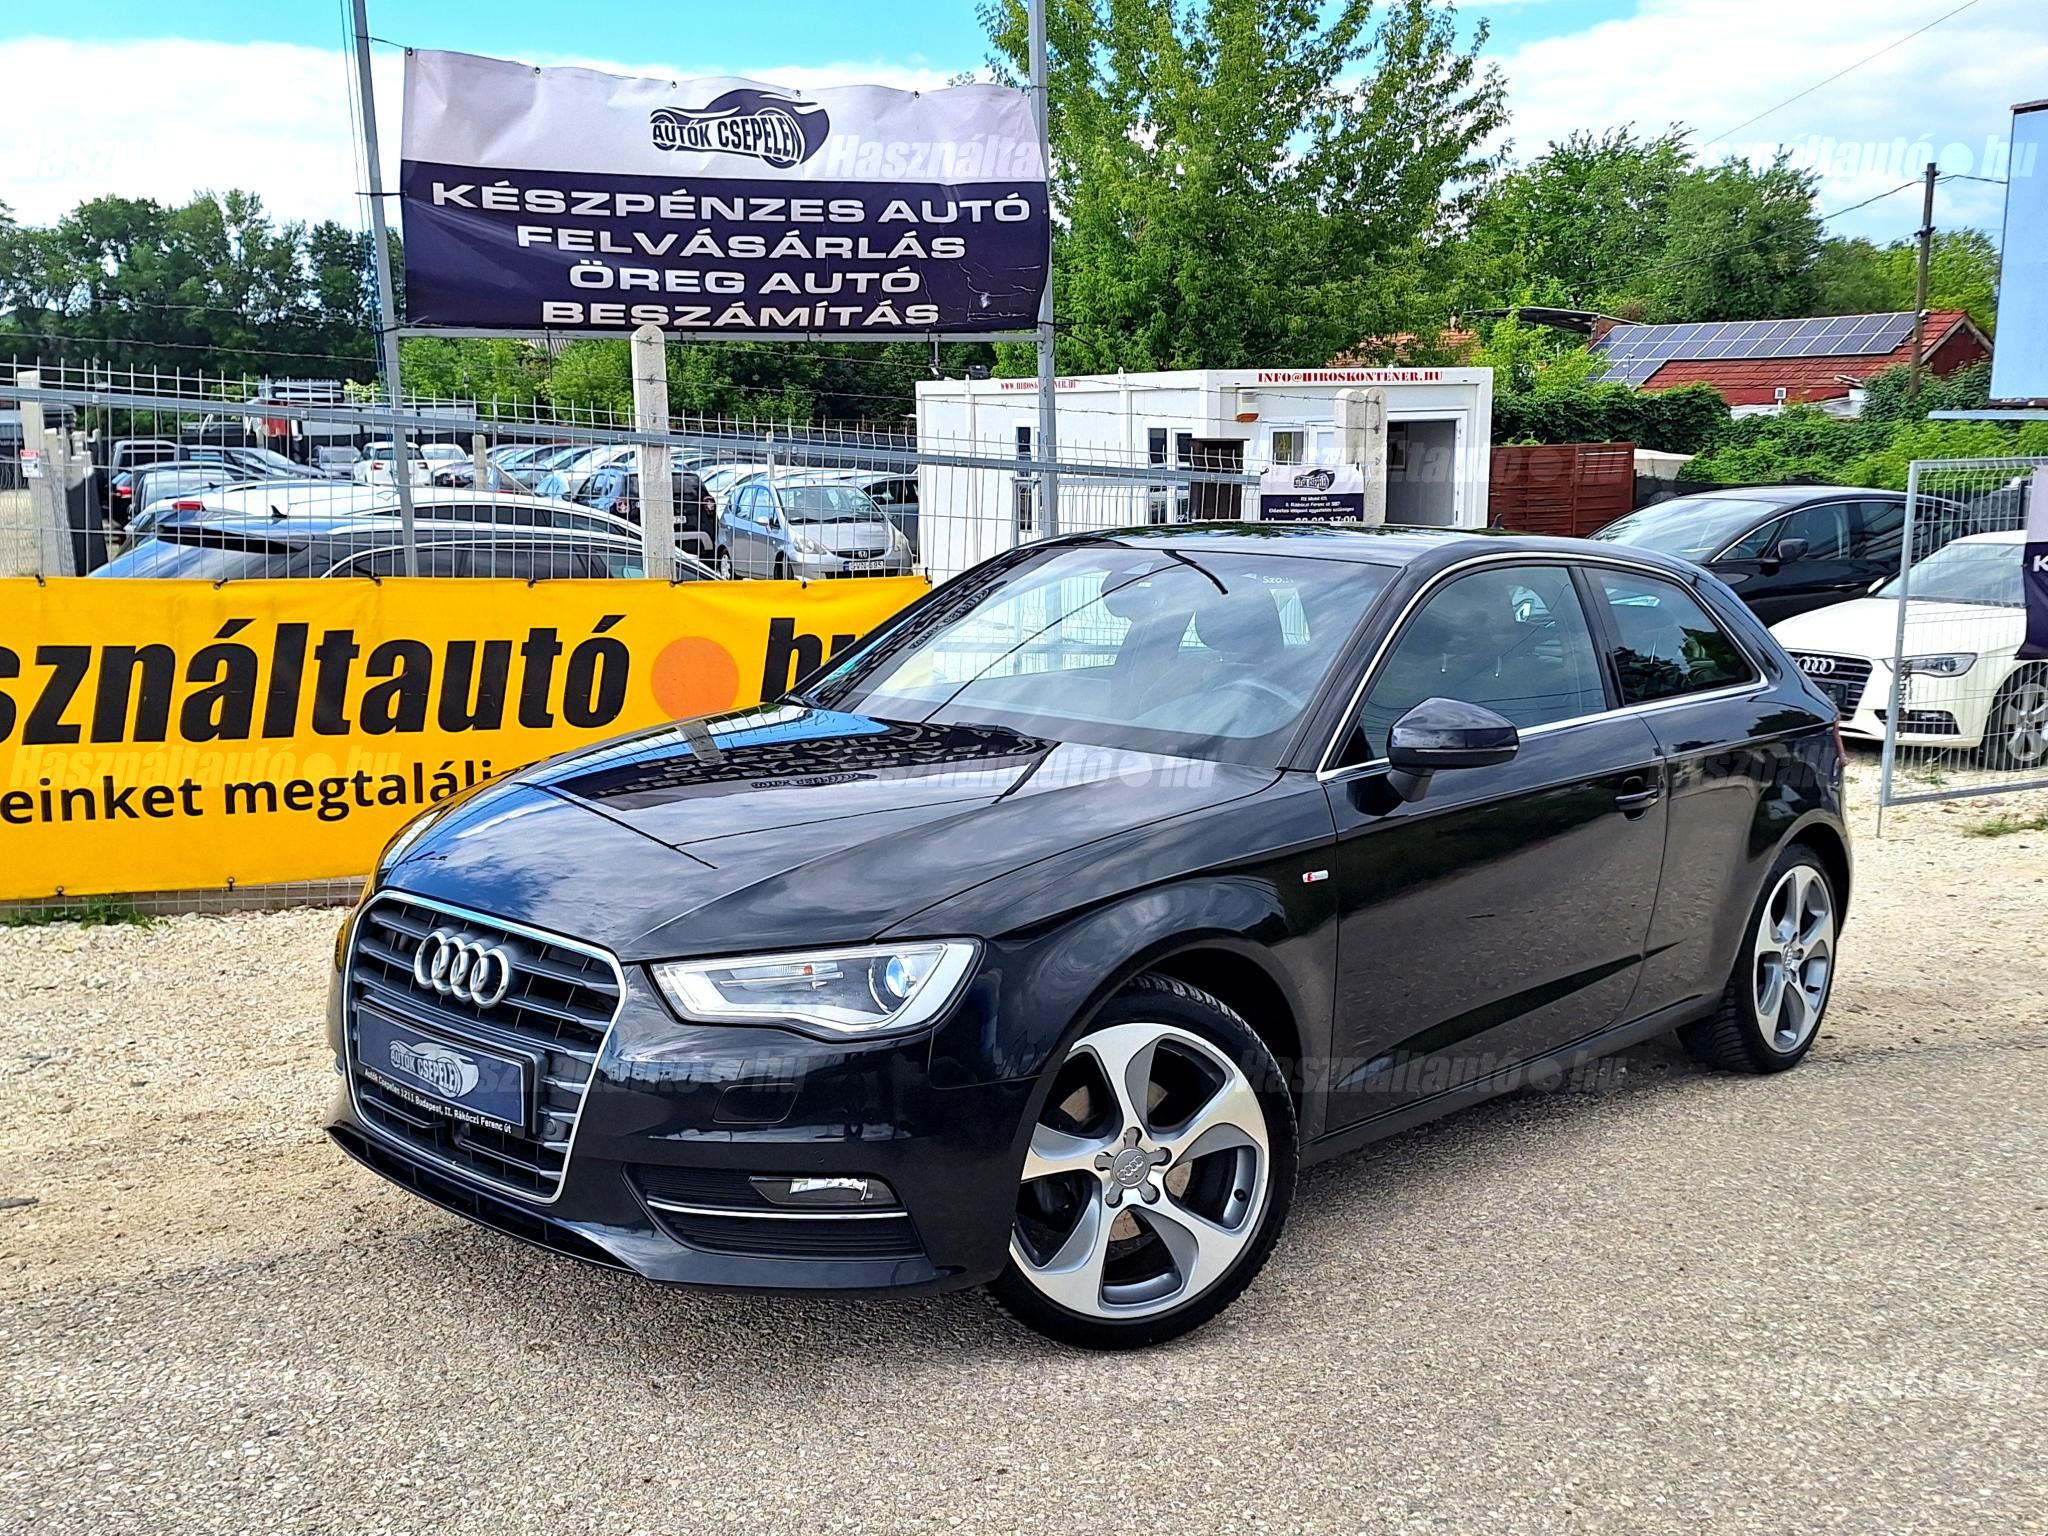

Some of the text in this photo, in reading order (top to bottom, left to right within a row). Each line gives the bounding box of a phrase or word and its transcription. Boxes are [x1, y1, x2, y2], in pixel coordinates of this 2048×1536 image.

[653, 115, 800, 160] AUTÓK CSEPELEN
[432, 180, 1031, 223] KÉSZPÉNZES AUTÓ
[516, 225, 966, 260] FELVÁSÁRLÁS
[569, 259, 920, 294] ÖREG AUTÓ
[542, 300, 940, 327] BESZÁMÍTÁS
[1258, 371, 1444, 383] INFO@HIROSKONTENER.HU
[0, 775, 203, 825] einket
[400, 1088, 416, 1103] 1211
[415, 1096, 443, 1115] Budapest,
[454, 1109, 480, 1126] Rákóczi
[480, 1117, 503, 1132] Ferenc
[504, 1123, 512, 1134] út
